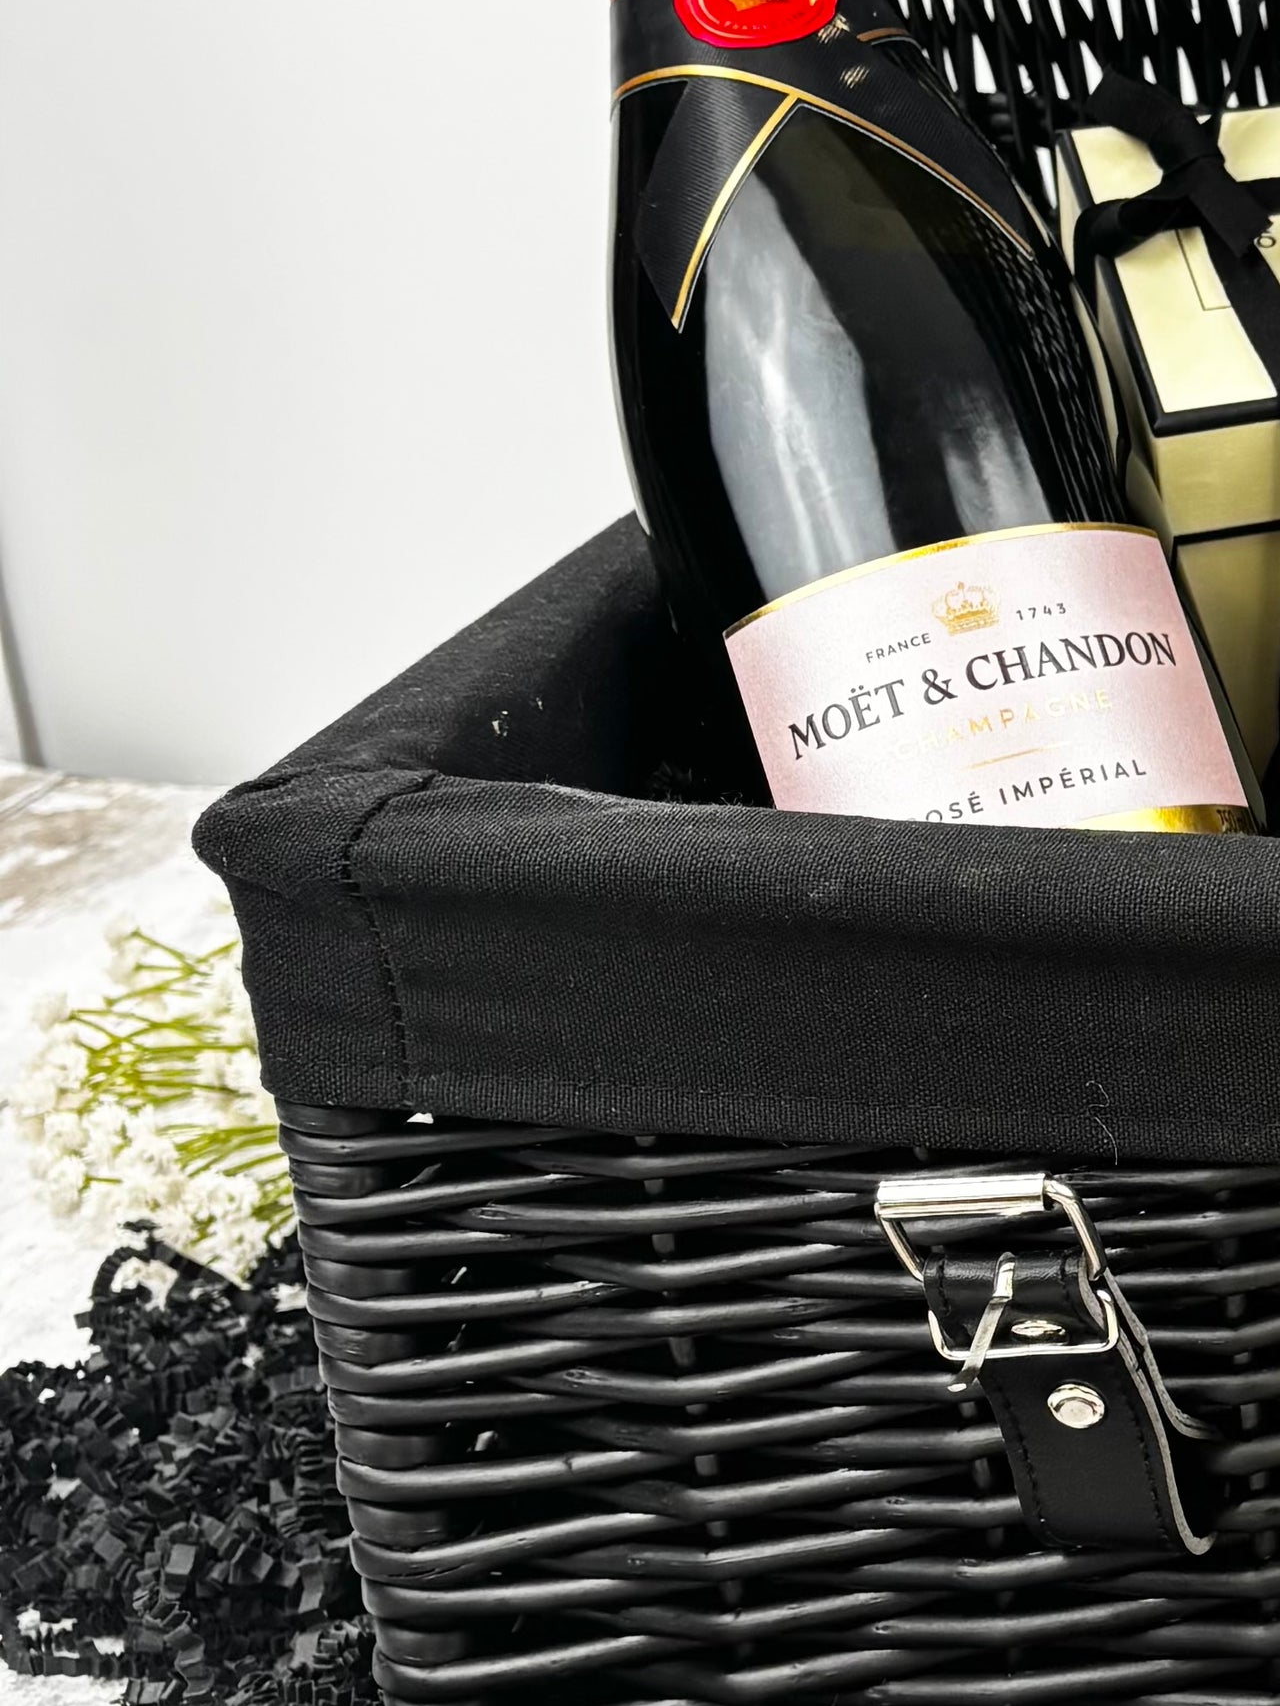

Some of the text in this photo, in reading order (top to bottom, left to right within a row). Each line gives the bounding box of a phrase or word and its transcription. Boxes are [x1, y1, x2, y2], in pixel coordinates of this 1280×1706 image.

[865, 602, 1068, 664] FRANCE 1743
[787, 630, 1177, 760] MOËT & CHANDON
[907, 759, 1147, 823] OSÉ IMPÉRIAL
